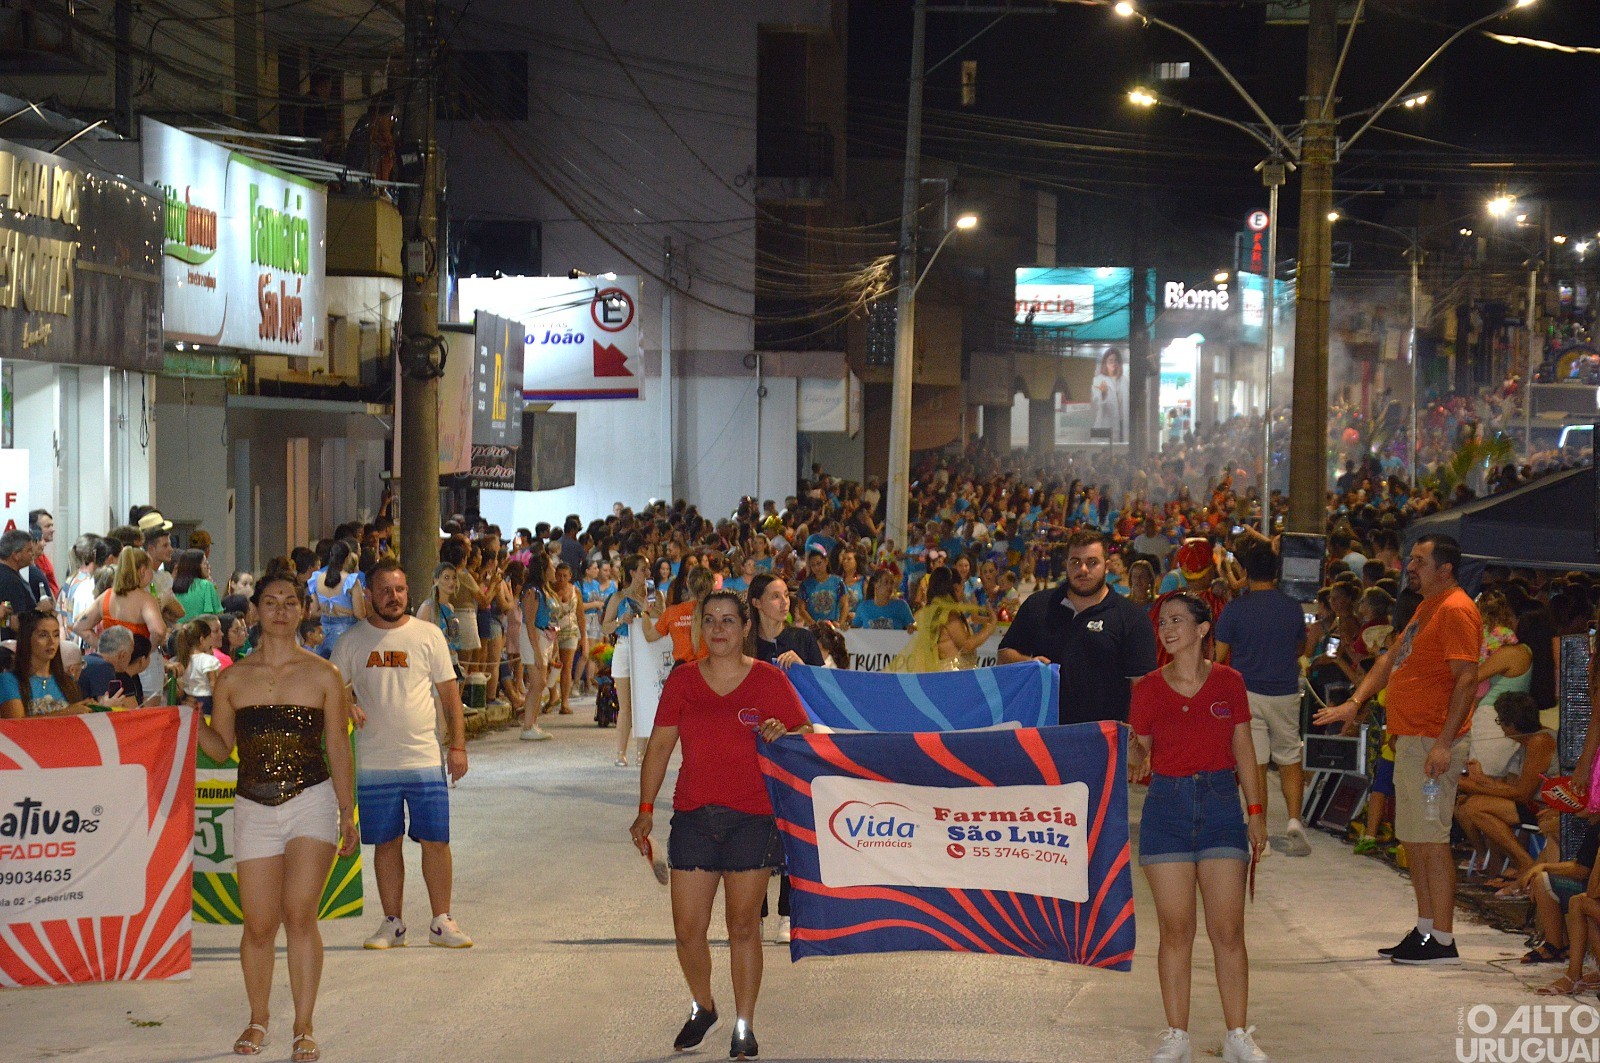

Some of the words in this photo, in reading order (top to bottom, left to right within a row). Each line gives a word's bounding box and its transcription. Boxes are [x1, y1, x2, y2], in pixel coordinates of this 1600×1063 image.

[250, 183, 309, 276] Farmácia
[1255, 214, 1263, 226] E
[258, 273, 279, 340] São
[281, 277, 303, 344] José
[541, 329, 585, 345] João
[366, 651, 408, 668] AIR
[195, 787, 237, 799] TAURAN
[846, 815, 915, 838] Vida
[933, 807, 1077, 827] Farmácia
[857, 838, 912, 848] Farmácias
[947, 825, 1002, 842] São
[1008, 826, 1070, 848] Luiz
[0, 841, 76, 860] FADOS
[973, 846, 990, 857] 55
[994, 847, 1068, 866] 3746-2074
[13, 897, 25, 906] 02
[34, 891, 84, 904] Seberi/RS
